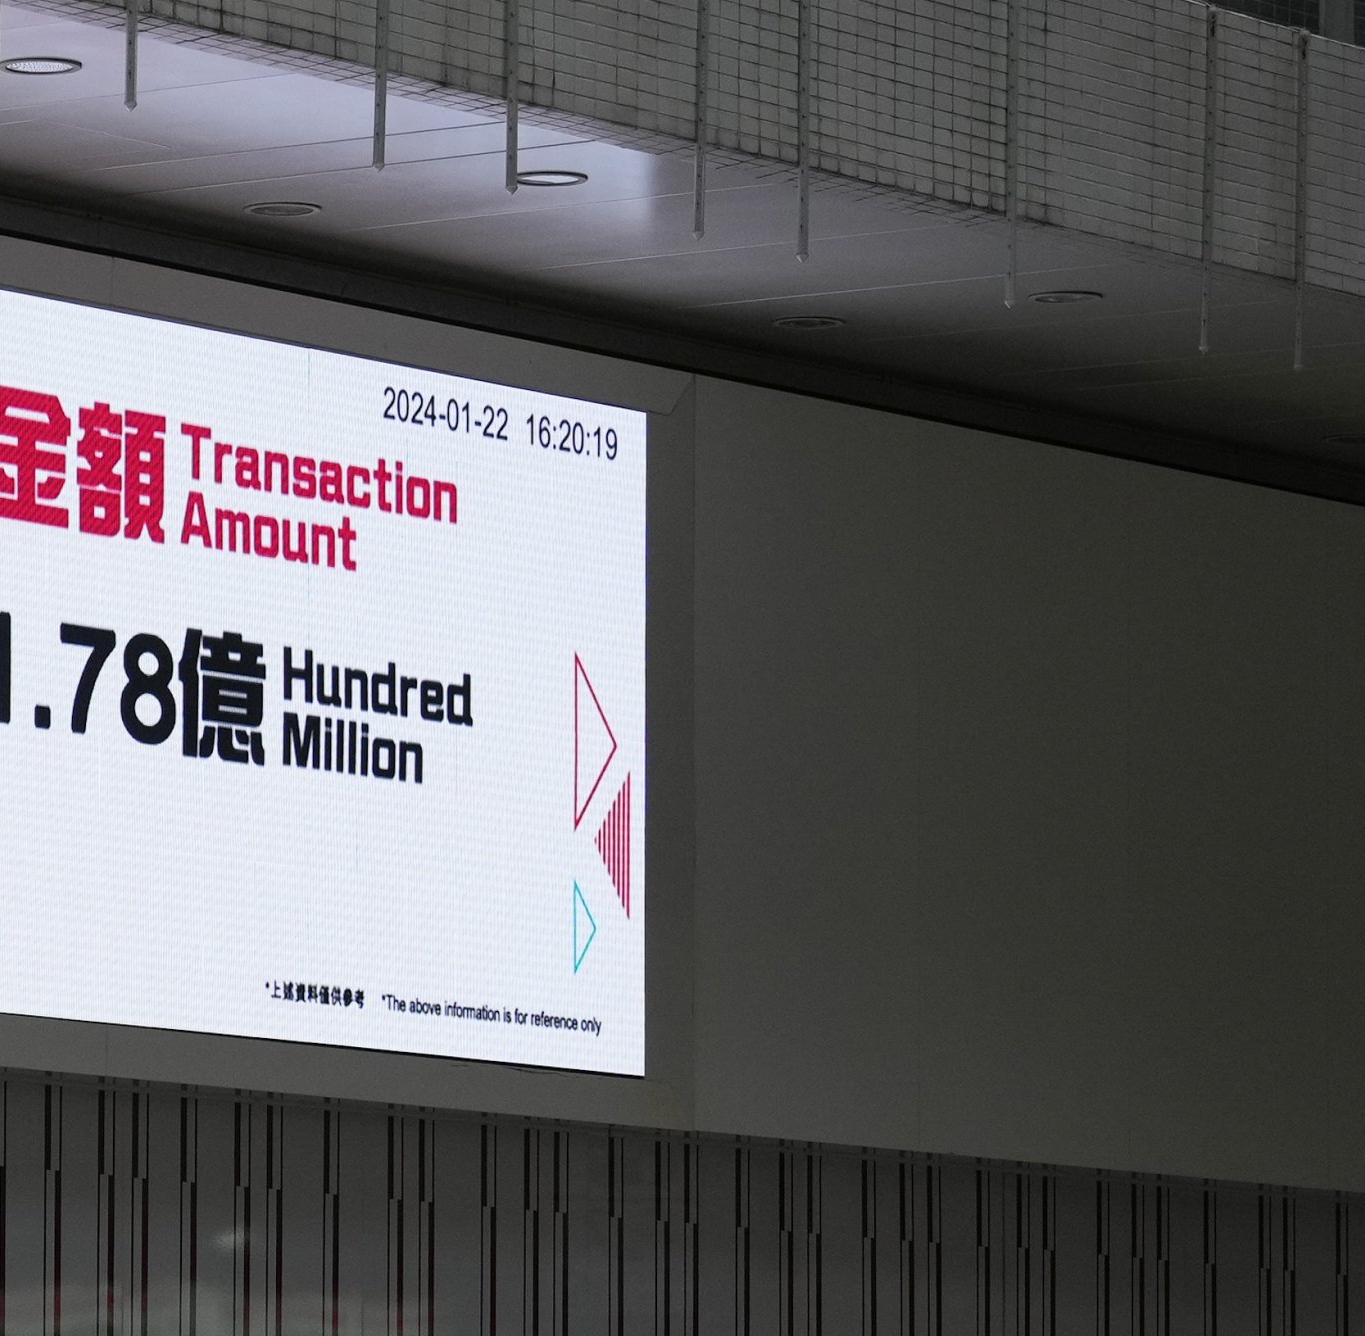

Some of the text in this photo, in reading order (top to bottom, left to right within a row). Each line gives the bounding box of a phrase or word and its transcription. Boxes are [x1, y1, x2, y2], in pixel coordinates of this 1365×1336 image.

[383, 386, 618, 461] 2024-01-22 16:20:19
[181, 423, 457, 524] Transaction
[180, 490, 356, 571] Amount
[283, 646, 473, 727] Hundred
[283, 712, 423, 784] Million
[409, 998, 441, 1016] above
[444, 1001, 500, 1022] information
[503, 1007, 512, 1023] is
[514, 1008, 528, 1025] for
[530, 1011, 578, 1031] reference
[580, 1017, 602, 1037] only
